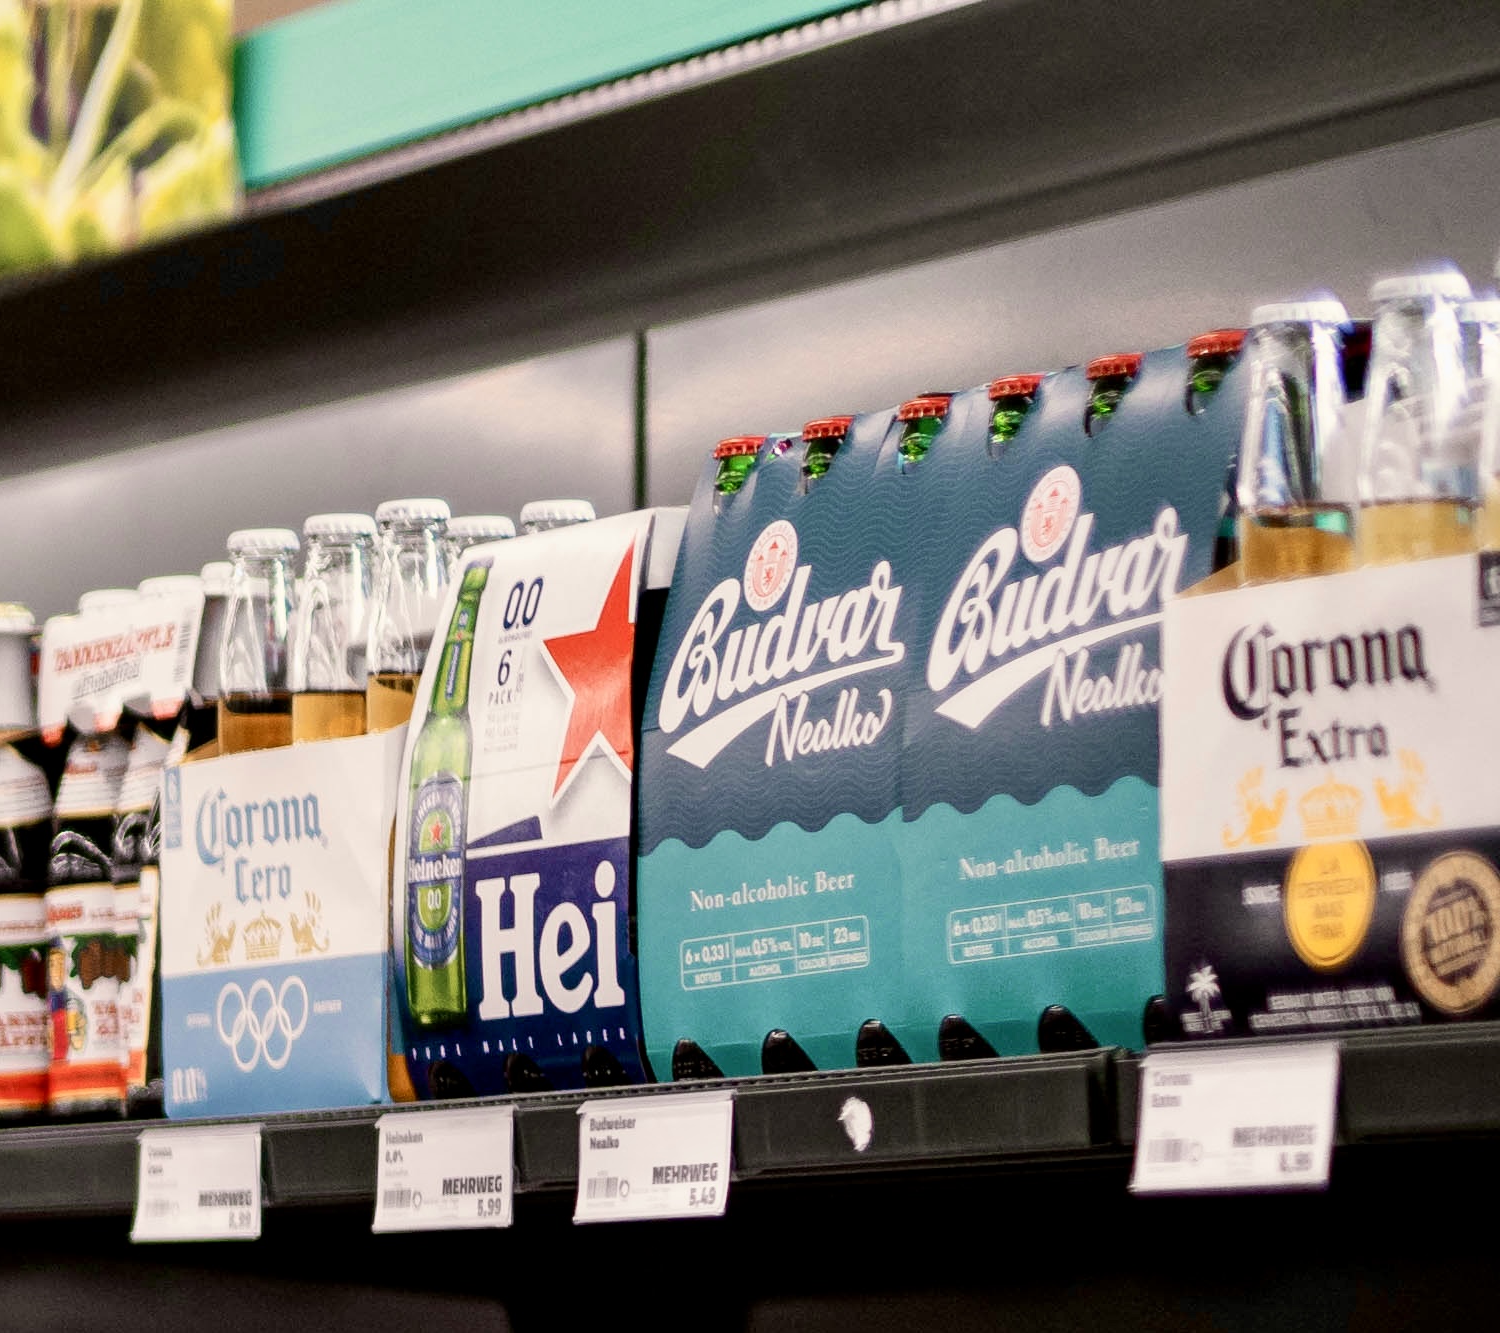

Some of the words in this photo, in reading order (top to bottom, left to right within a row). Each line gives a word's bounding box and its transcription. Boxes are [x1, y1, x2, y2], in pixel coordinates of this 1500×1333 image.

[928, 506, 1189, 691] Budvar
[498, 649, 512, 687] 6
[658, 560, 906, 733] Budvar
[1041, 643, 1164, 727] Nealko
[1222, 620, 1438, 728] Corona
[765, 689, 892, 767] Nealko
[1279, 707, 1388, 767] Extra
[196, 788, 329, 872] Corona
[1094, 837, 1140, 860] Beer
[236, 856, 291, 906] Cero
[690, 875, 807, 911] Non-alcoholic
[814, 871, 855, 894] Beer
[476, 859, 625, 1022] Hei
[589, 1117, 636, 1132] Budweiser
[589, 1136, 620, 1150] Nealko
[442, 1175, 503, 1196] MEHRWEG
[652, 1162, 718, 1185] MEHRWEG
[688, 1186, 717, 1207] 5,49
